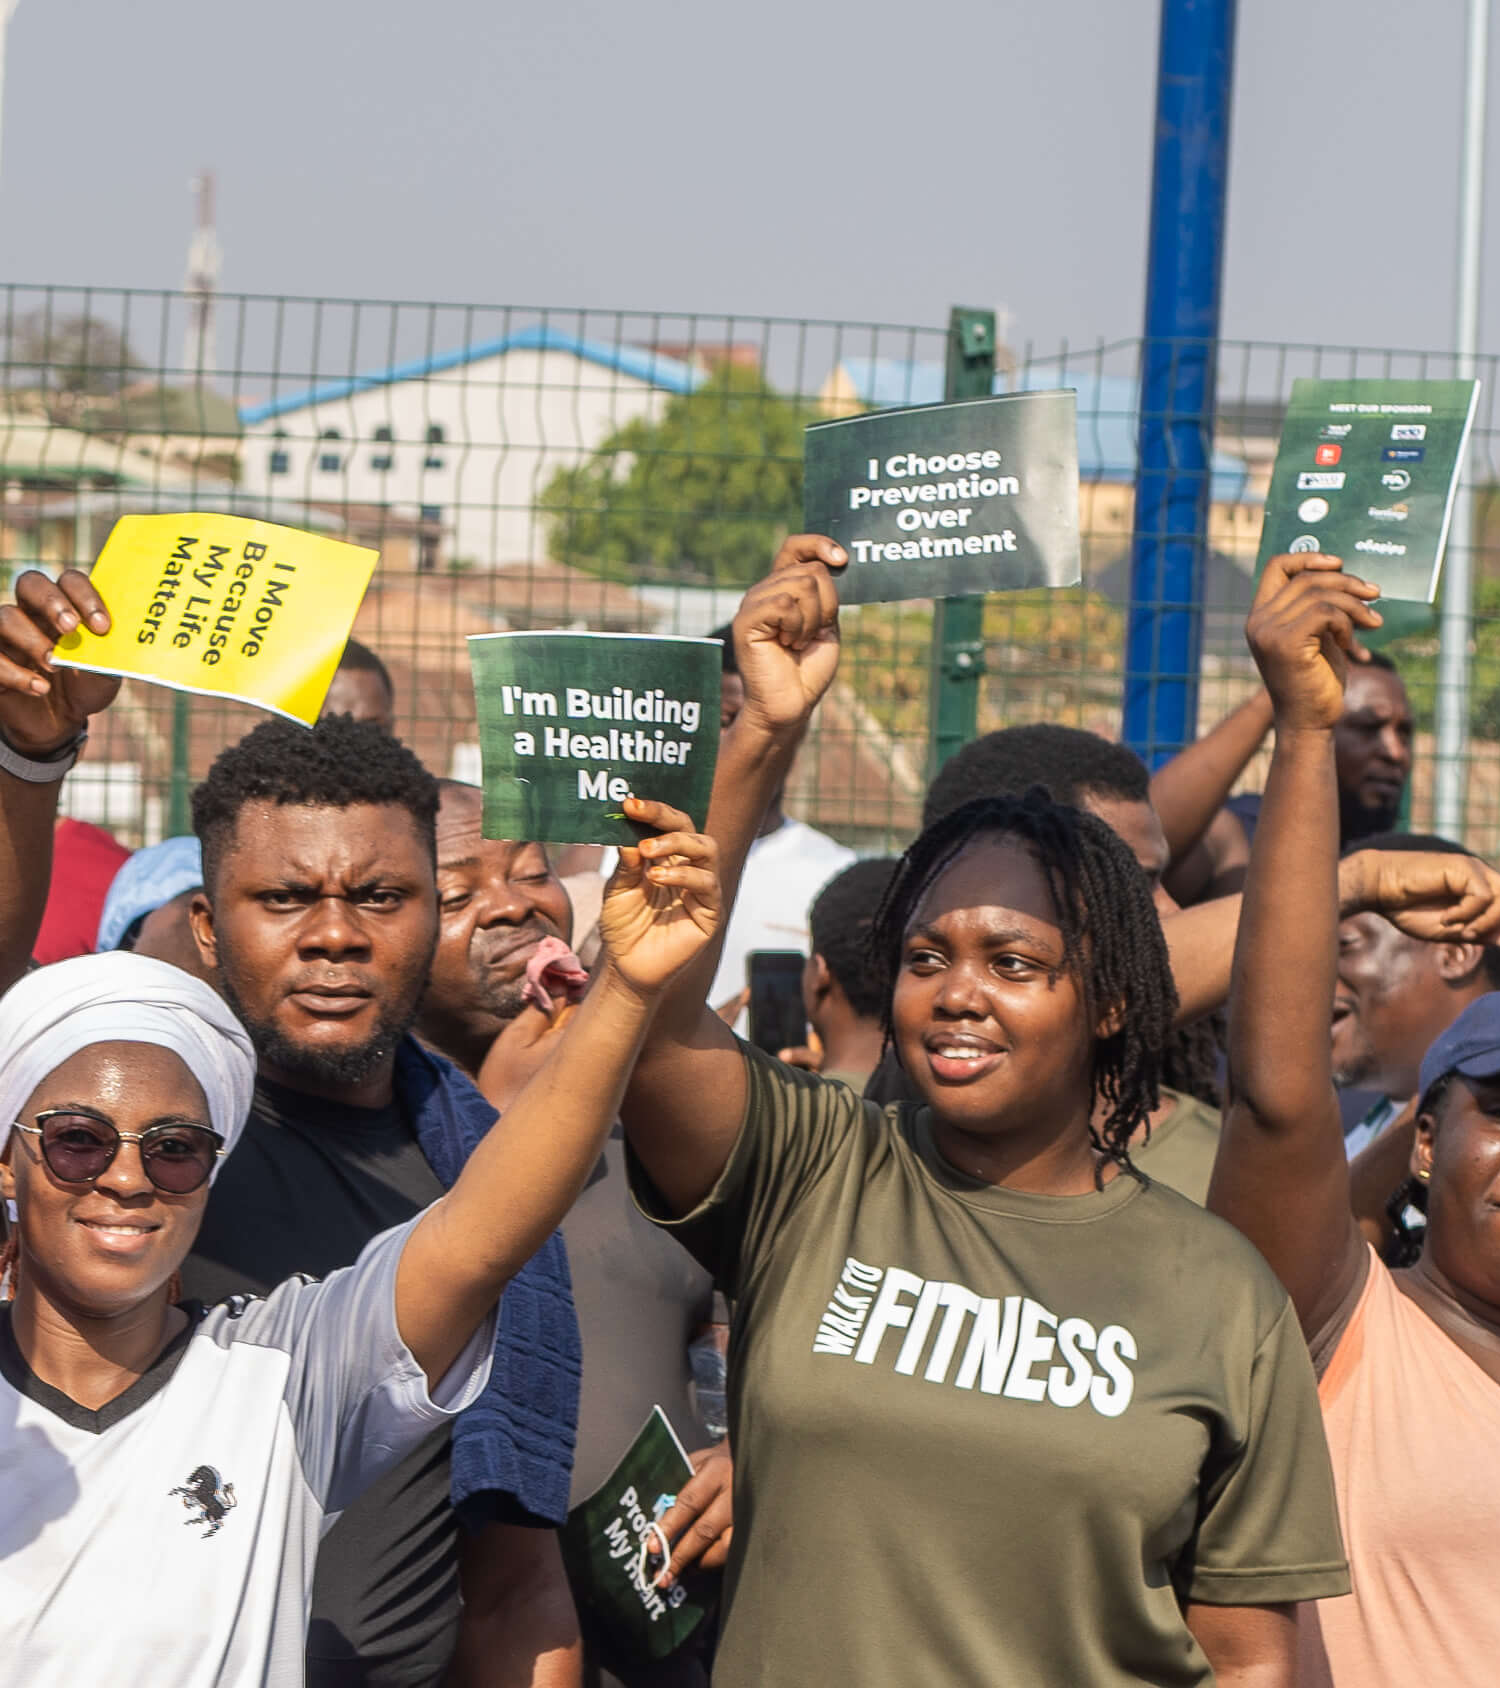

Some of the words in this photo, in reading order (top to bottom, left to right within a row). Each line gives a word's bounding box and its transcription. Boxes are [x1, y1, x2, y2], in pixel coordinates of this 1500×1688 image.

[868, 458, 879, 481] I
[885, 449, 1001, 479] Choose
[849, 473, 1020, 510] Prevention
[896, 508, 972, 531] Over
[193, 544, 231, 588] My
[273, 562, 297, 573] I
[851, 529, 1018, 563] Treatment
[137, 536, 199, 645] Matters
[202, 541, 268, 666] Because
[172, 596, 211, 649] Life
[241, 579, 290, 658] Move
[501, 685, 558, 717] I'm
[566, 686, 701, 734] Building
[513, 731, 535, 756] a
[544, 726, 693, 766] Healthier
[577, 768, 635, 802] Me.
[812, 1284, 872, 1356] WALK
[844, 1256, 884, 1292] TO
[855, 1266, 1139, 1418] FITNESS
[604, 1517, 632, 1559] My
